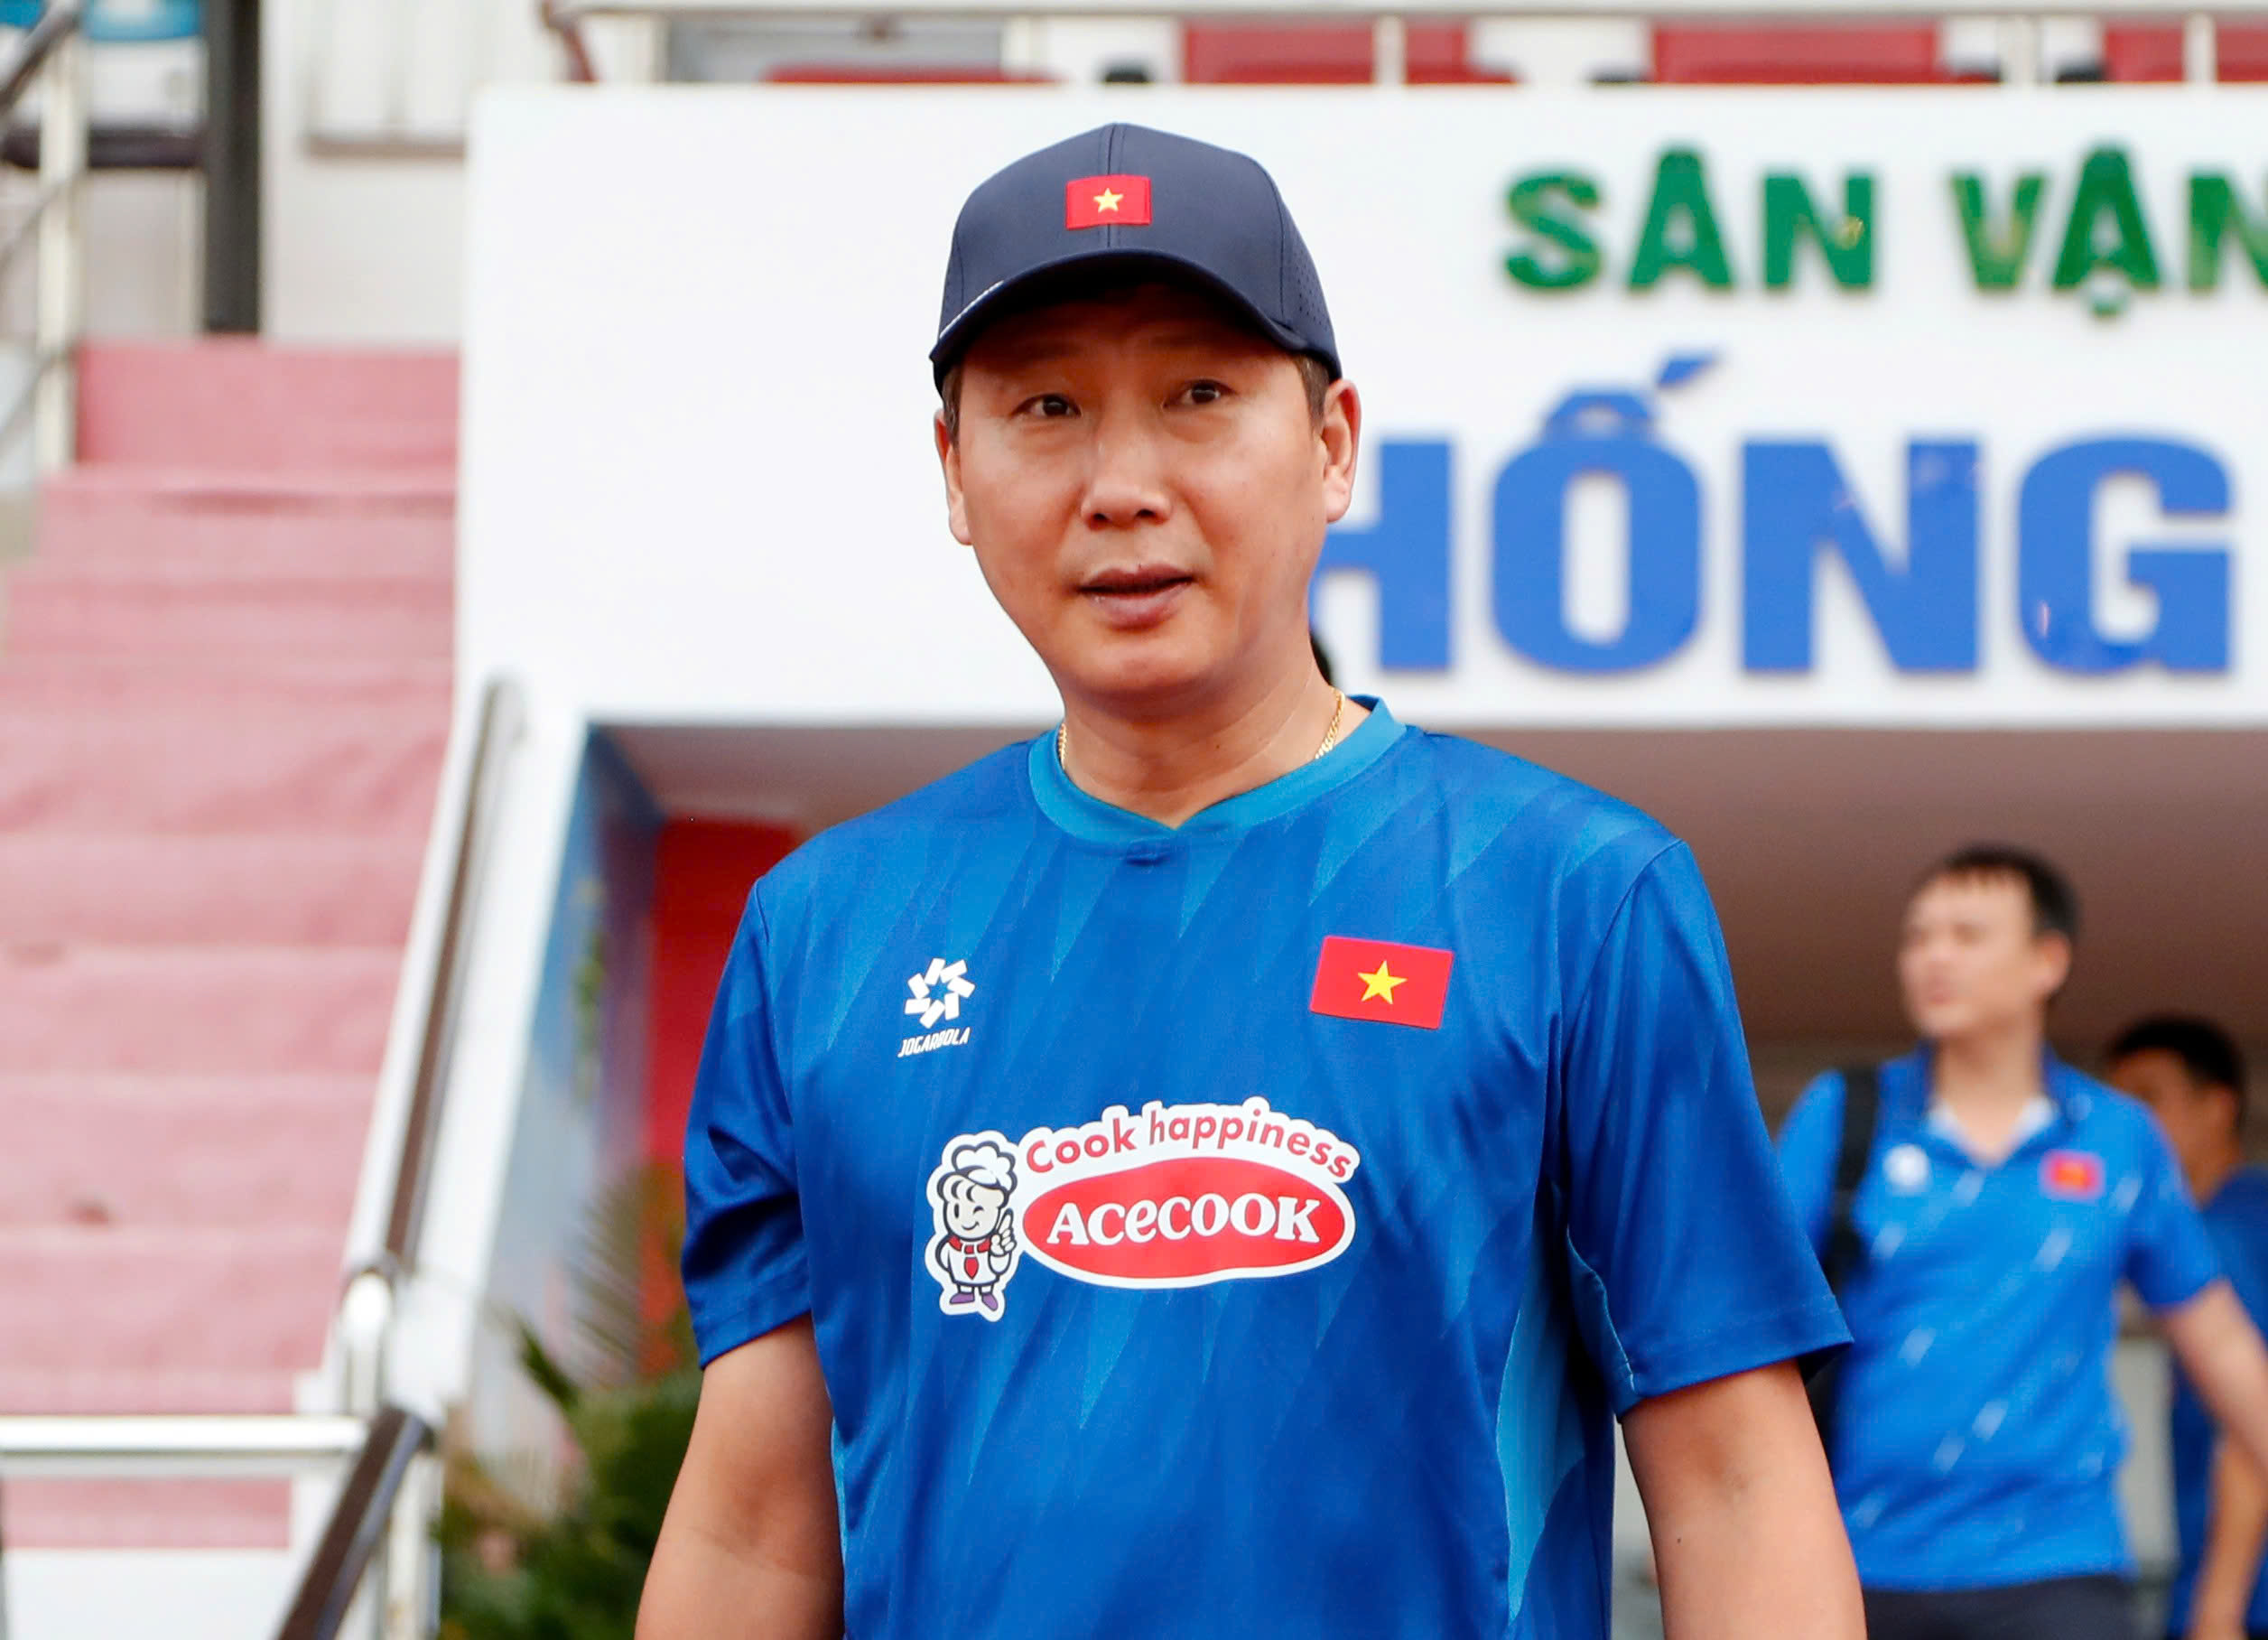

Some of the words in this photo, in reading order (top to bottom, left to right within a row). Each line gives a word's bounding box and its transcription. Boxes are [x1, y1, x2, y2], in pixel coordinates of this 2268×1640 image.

[1502, 144, 1879, 291] SÂN
[1026, 1117, 1138, 1174] Cook
[1148, 1108, 1352, 1179] happiness
